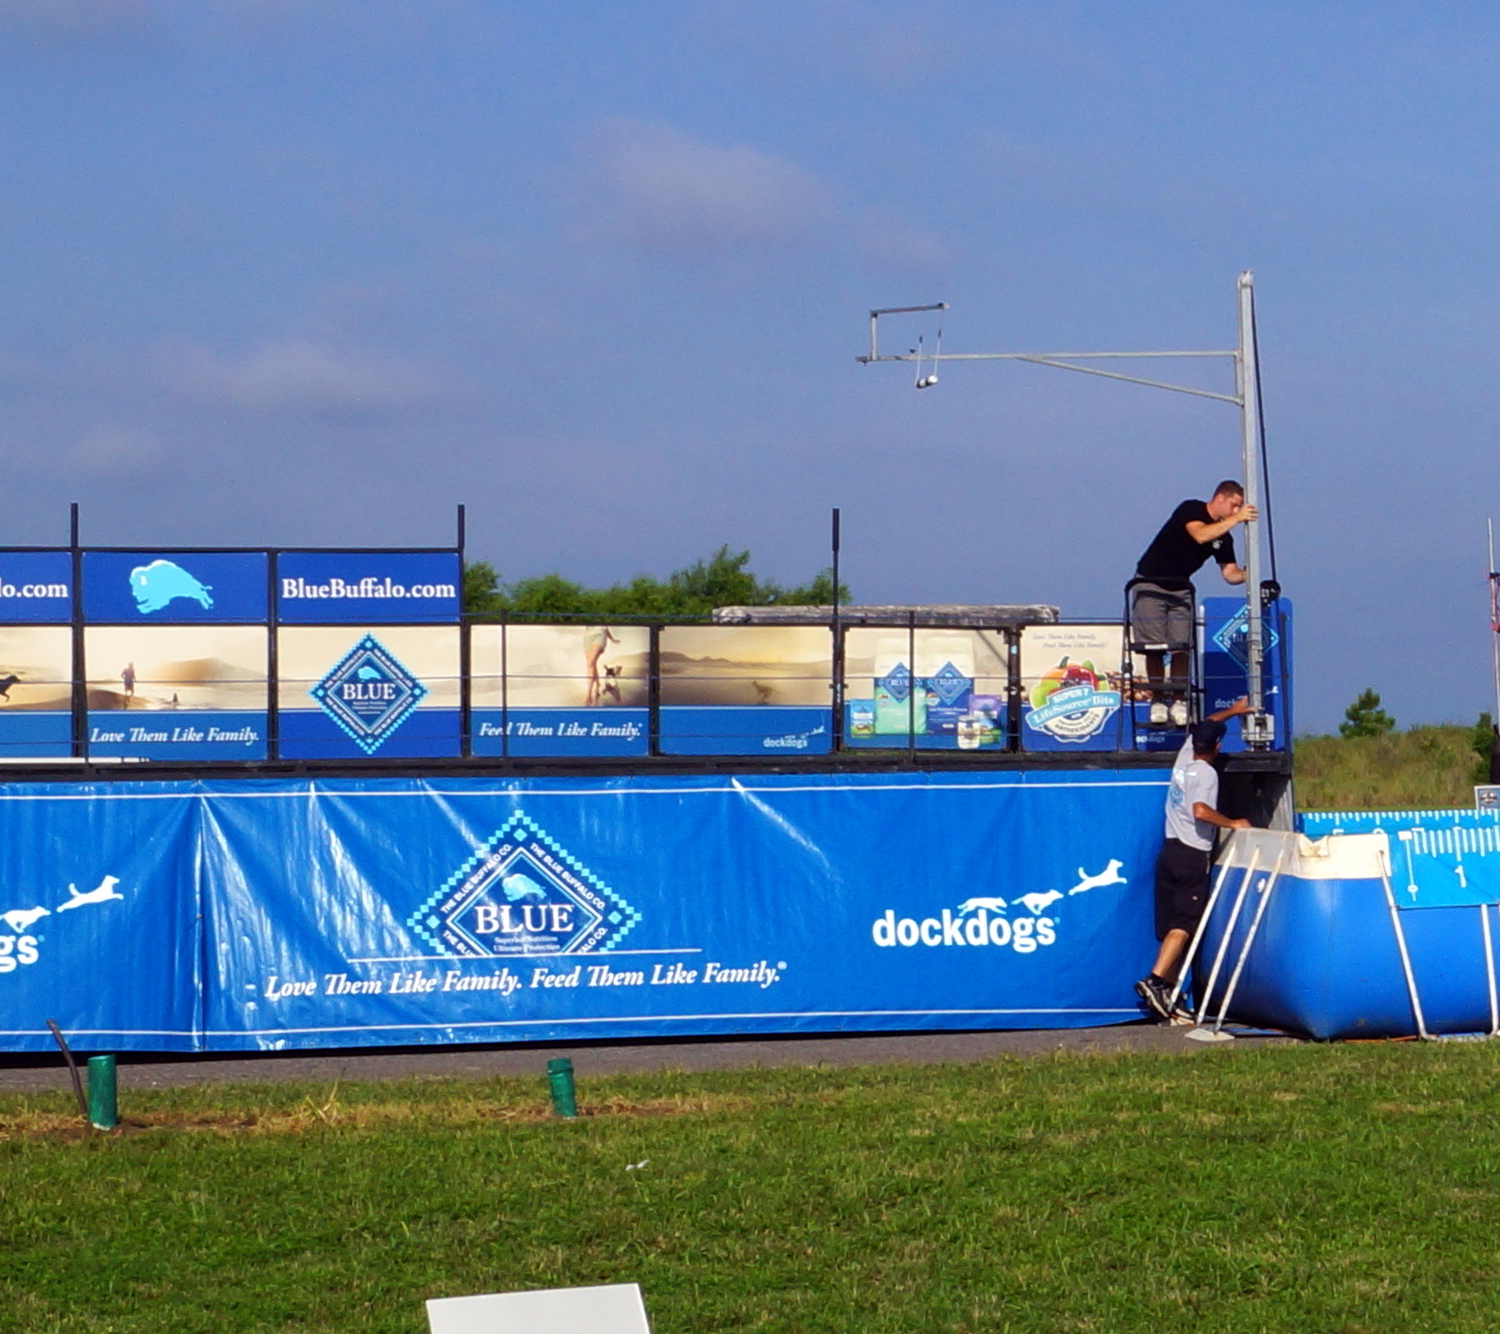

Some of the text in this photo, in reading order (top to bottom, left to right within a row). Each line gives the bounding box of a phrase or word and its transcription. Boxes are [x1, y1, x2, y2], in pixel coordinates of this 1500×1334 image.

[282, 578, 456, 599] BlueBuffalo.com
[343, 683, 396, 700] BLUE
[1053, 688, 1089, 704] SUPER 7
[1093, 695, 1115, 705] Bits
[91, 727, 260, 746] Love Them Like Family.
[517, 722, 553, 737] Them
[557, 722, 588, 737] Like
[763, 736, 808, 749] dockdogs
[530, 842, 545, 859] THE
[542, 854, 563, 873] BLUE
[560, 870, 595, 901] BUFFALO
[1455, 865, 1467, 888] 1
[440, 898, 456, 914] THE
[454, 881, 473, 903] BLUE
[475, 904, 574, 934] BLUE
[442, 930, 458, 946] THE
[872, 908, 1056, 953] dockdogs
[265, 960, 781, 998] Love Them Like Family. Feed Them Like Family.
